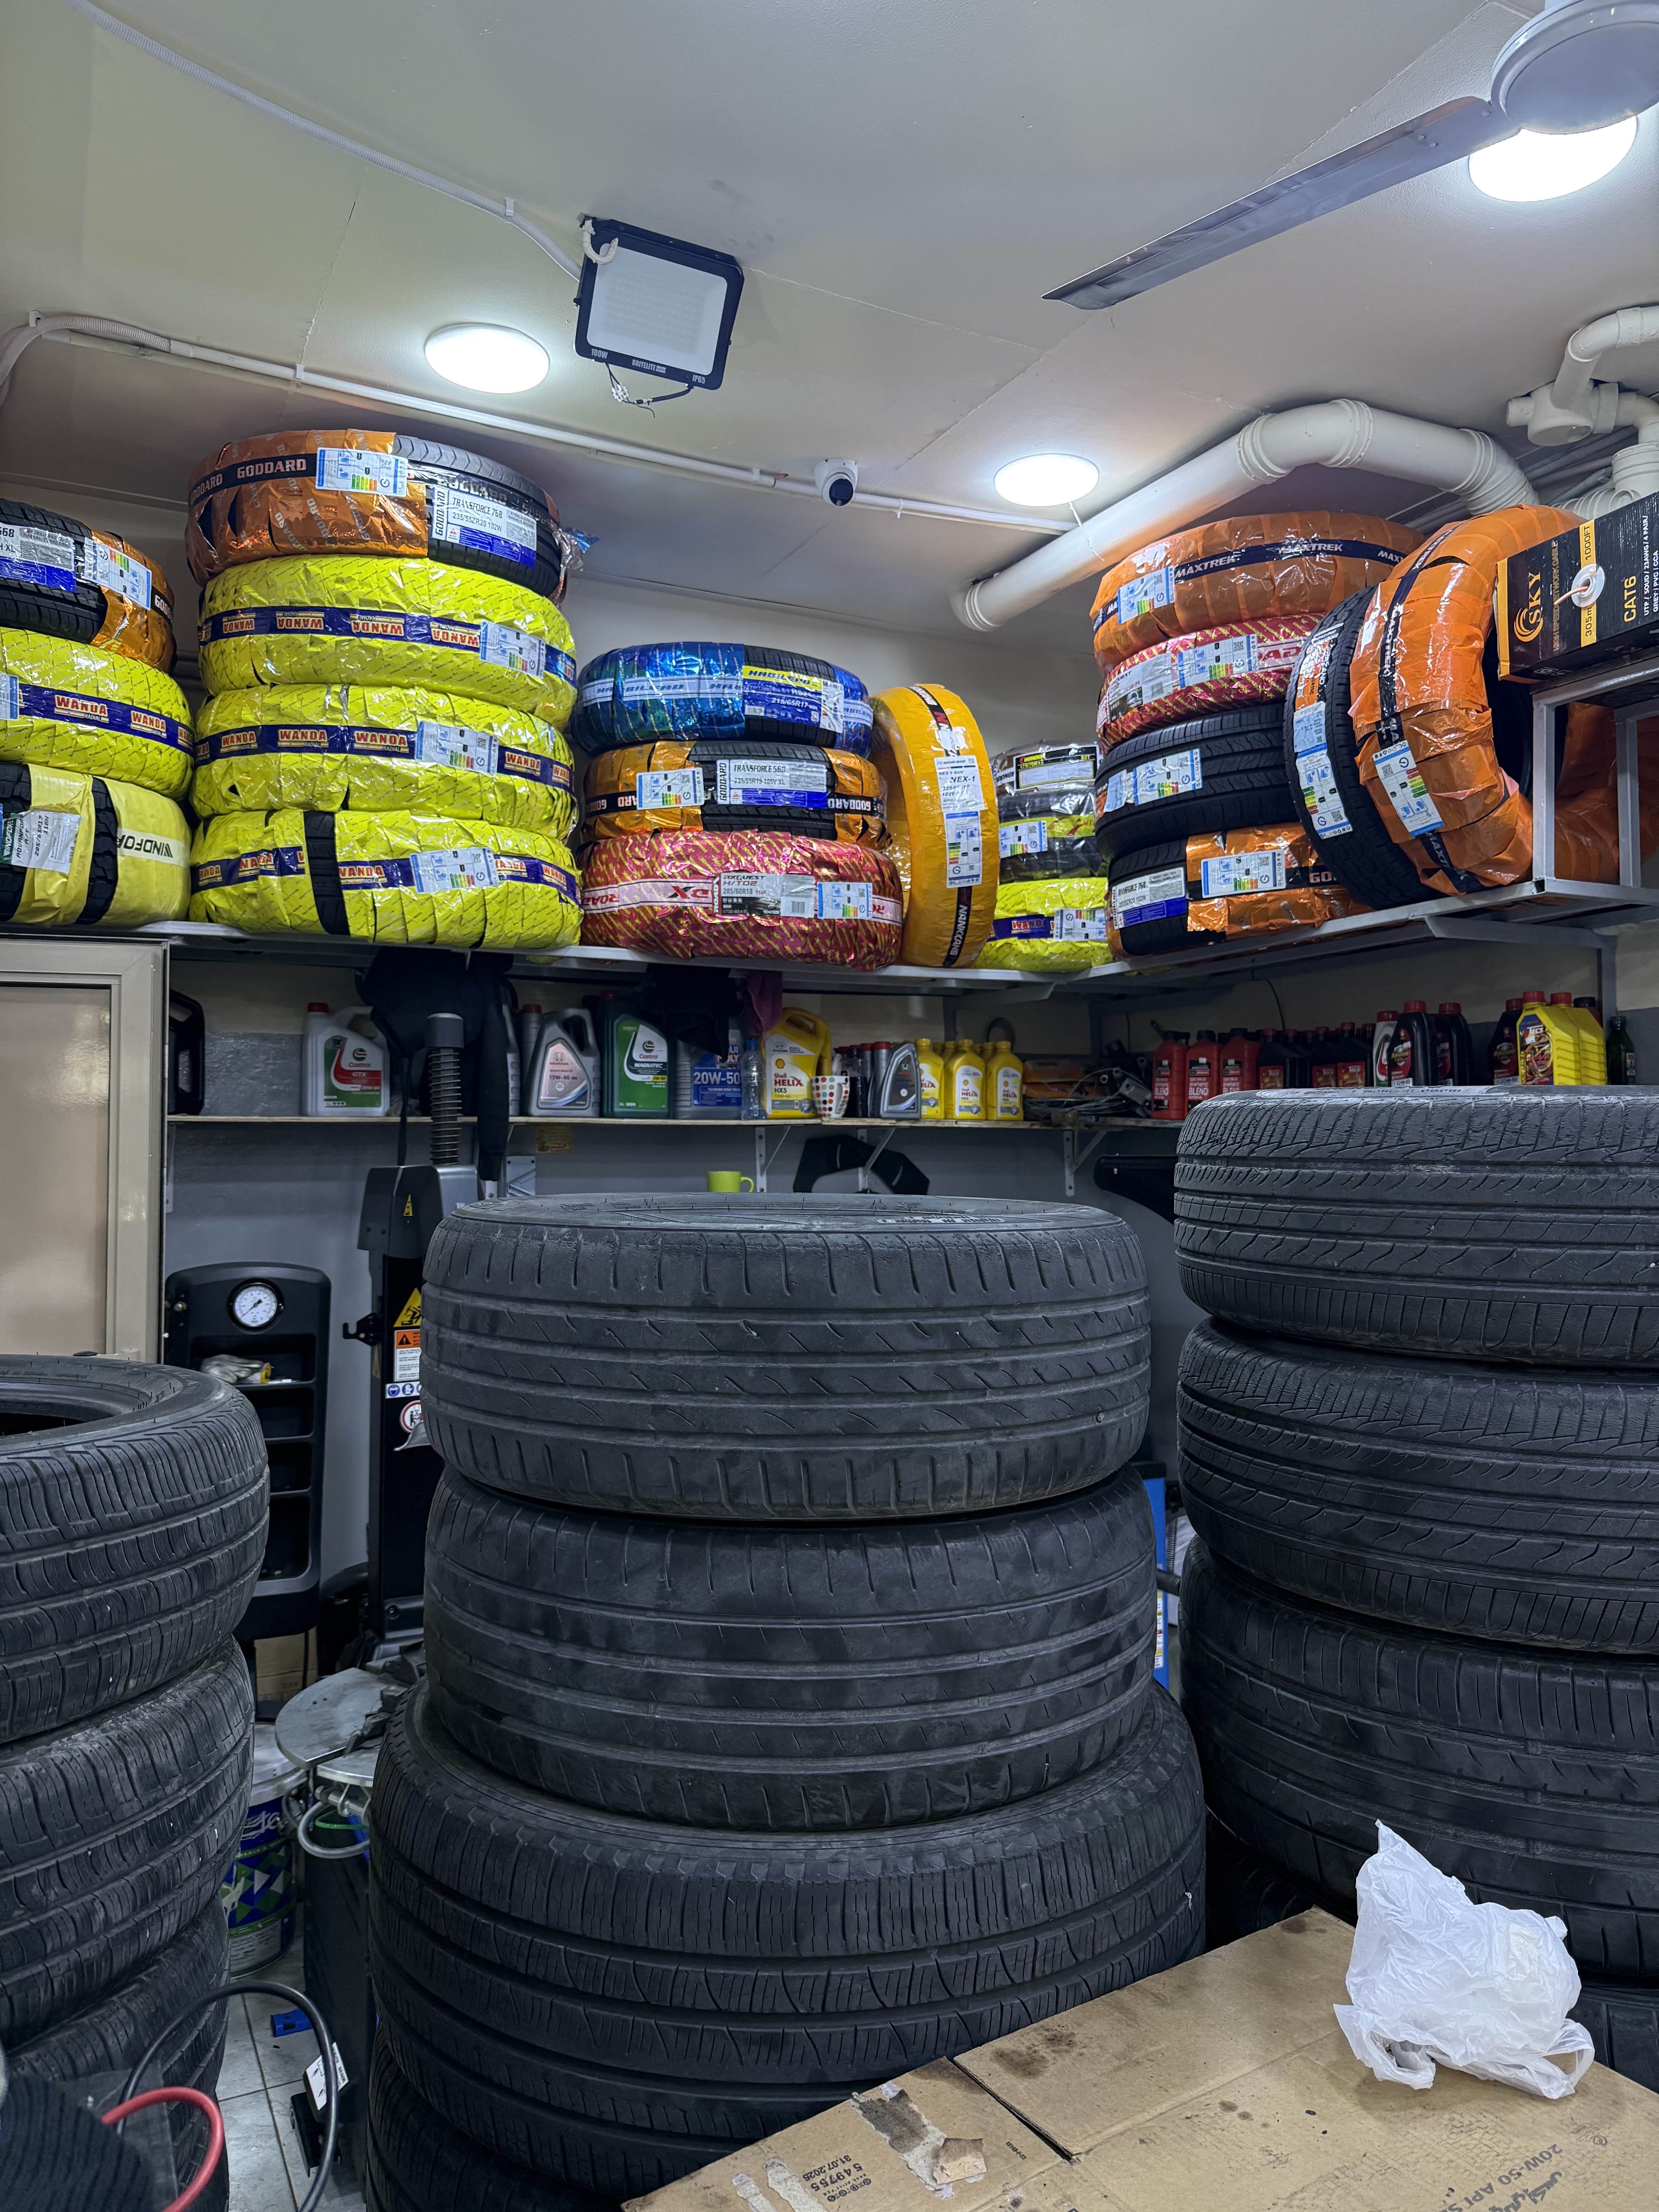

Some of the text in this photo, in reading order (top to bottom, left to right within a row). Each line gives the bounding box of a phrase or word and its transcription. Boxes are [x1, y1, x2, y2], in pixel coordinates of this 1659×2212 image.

[591, 349, 608, 359] 100W
[632, 359, 656, 371] BRITELITE
[692, 374, 706, 385] IP65
[237, 459, 307, 479] GODDARD
[435, 491, 445, 536] GODDARD
[452, 497, 491, 515] TRANSFORCE
[492, 508, 503, 519] 768
[452, 512, 502, 532] 235/55ZR20 102W
[0, 527, 15, 538] 68
[1175, 555, 1236, 579] MAXTREK
[1529, 572, 1543, 625] SKY
[1624, 576, 1637, 622] CAT6
[276, 617, 324, 630] WANDA
[351, 620, 404, 637] WANDA
[771, 697, 808, 708] 215/65R17
[55, 695, 166, 732] WANDA WANDA
[84, 713, 101, 722] RADIAL
[222, 729, 541, 769] WANDA WANDA WANDA WANDA
[733, 764, 772, 773] TRANSFORCE
[949, 905, 969, 957] NANKANG
[693, 1072, 740, 1085] 20W-50
[774, 1076, 804, 1087] HELIX
[1154, 1088, 1170, 1097] BLEND
[1188, 1087, 1209, 1097] BLEND
[802, 2154, 851, 2183] 31.07.2025
[1498, 2144, 1563, 2187] 20W-50
